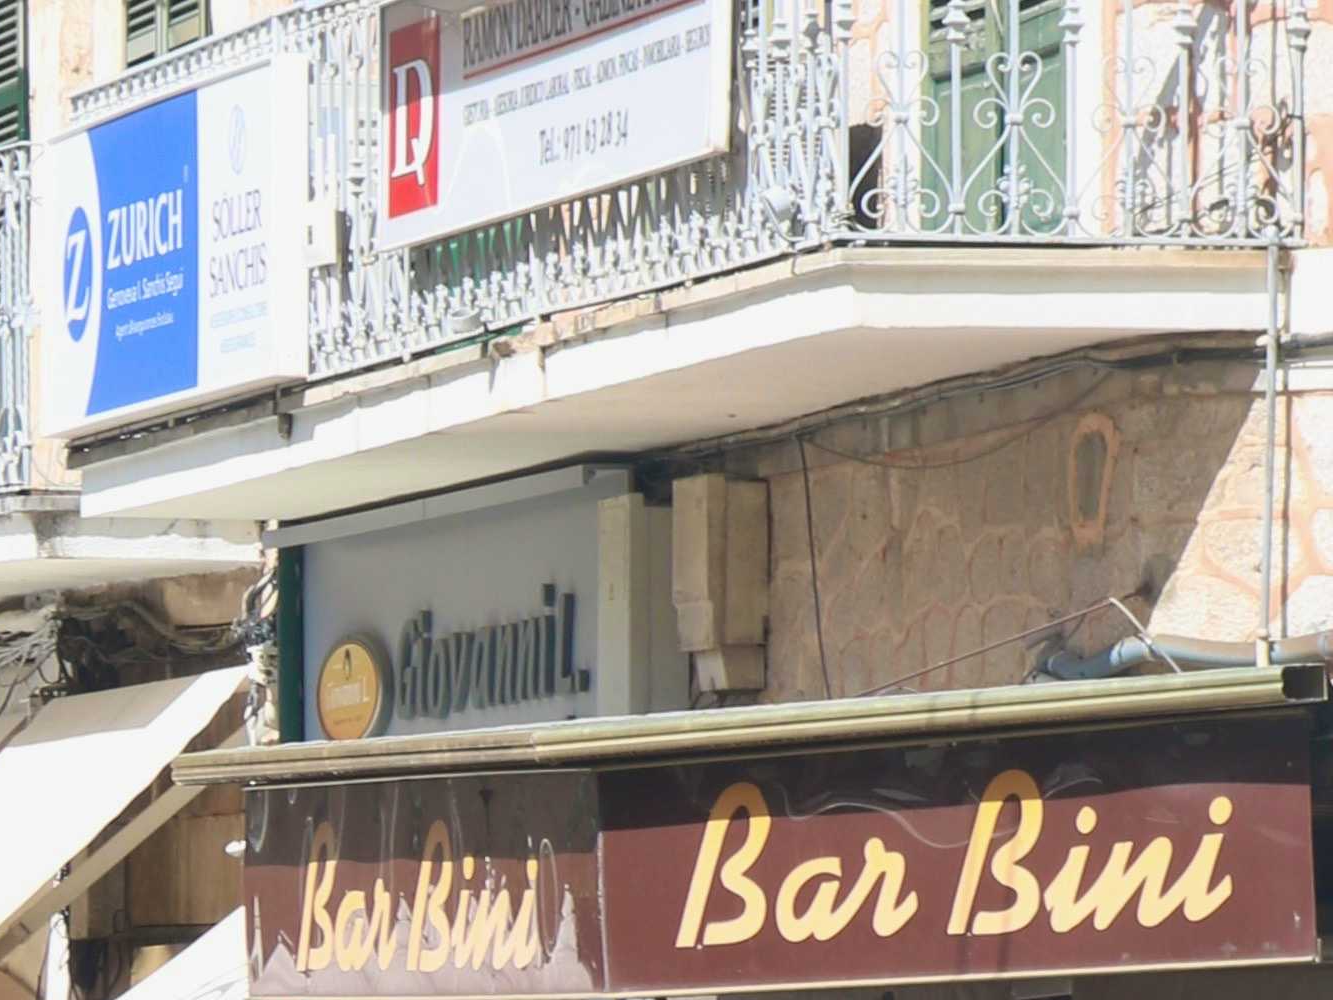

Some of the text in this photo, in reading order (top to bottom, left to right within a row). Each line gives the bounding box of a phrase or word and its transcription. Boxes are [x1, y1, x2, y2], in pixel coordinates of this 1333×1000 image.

[463, 3, 514, 67] RAMON
[564, 122, 581, 161] 971
[585, 118, 597, 155] 63
[600, 111, 613, 147] 28
[616, 108, 629, 146] 34
[107, 189, 183, 271] ZURICH
[209, 242, 268, 298] SANCHIS
[397, 584, 556, 720] Giovanni
[298, 821, 541, 972] Bar Bini
[675, 769, 1232, 949] Bar Bini
